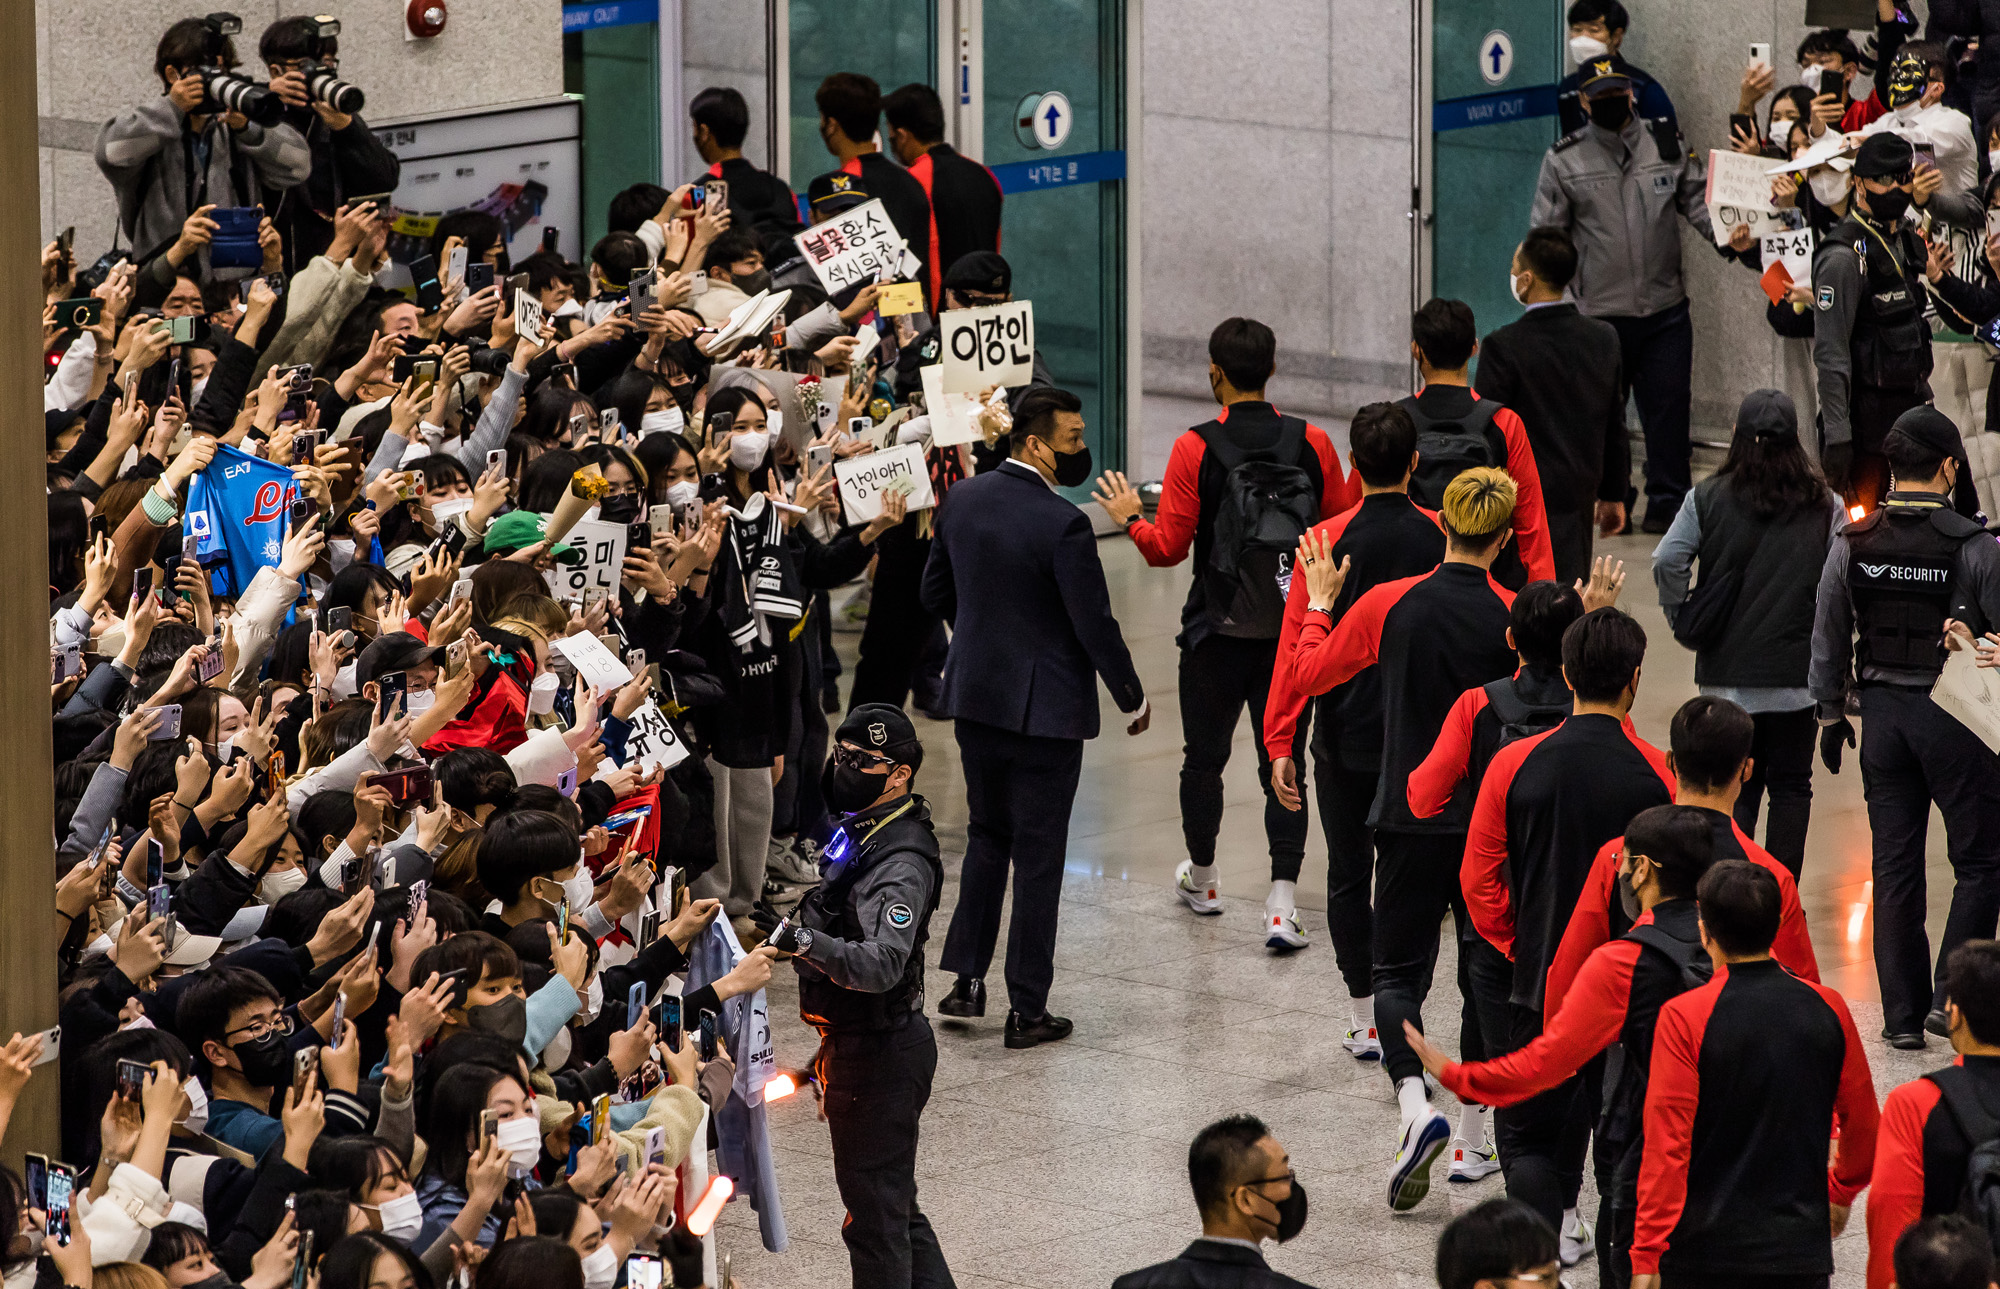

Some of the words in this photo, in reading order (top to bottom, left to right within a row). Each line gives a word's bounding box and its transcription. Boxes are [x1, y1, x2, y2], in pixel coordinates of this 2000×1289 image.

[593, 6, 619, 23] OUT
[1467, 103, 1494, 120] WAY
[1500, 99, 1524, 117] OUT
[1028, 165, 1062, 184] 나가는
[1067, 162, 1078, 180] 문
[1766, 234, 1809, 256] 조규성
[952, 311, 1030, 371] 이강인
[224, 461, 251, 479] EA7
[1890, 566, 1948, 582] SECURITY
[585, 644, 598, 653] LEE
[587, 658, 612, 676] 18
[624, 708, 676, 764] 규성
